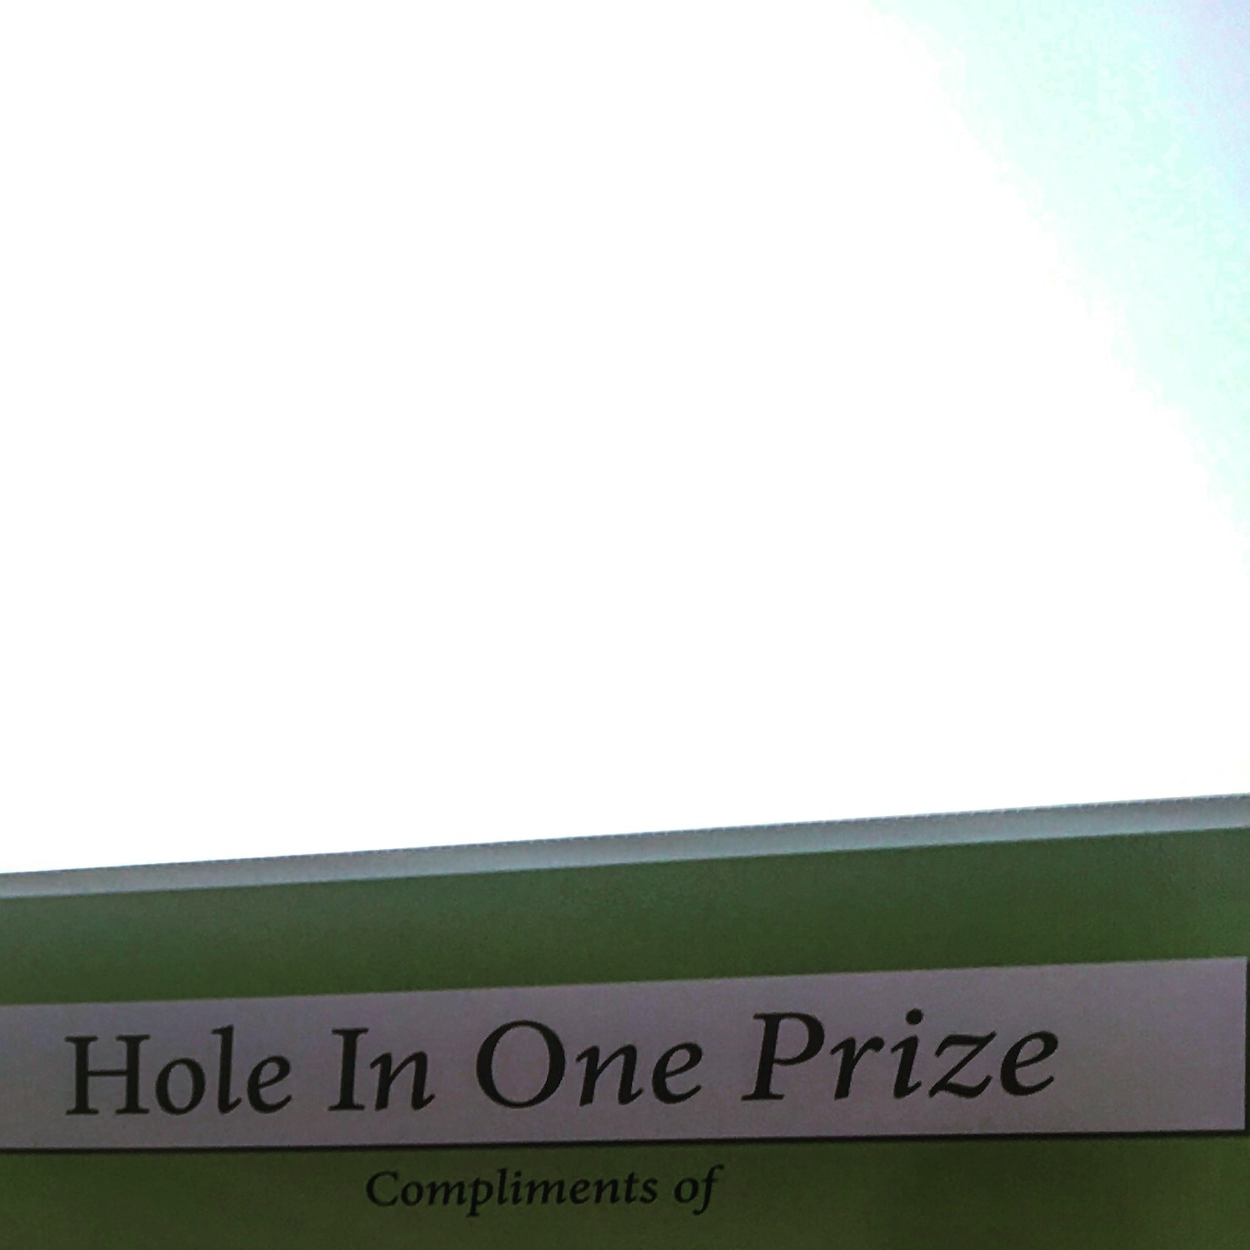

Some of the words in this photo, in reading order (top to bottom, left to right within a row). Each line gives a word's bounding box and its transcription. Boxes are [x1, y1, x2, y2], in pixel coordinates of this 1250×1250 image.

[65, 1026, 292, 1116] Hole
[329, 1027, 436, 1112] In
[476, 1020, 703, 1109] One
[741, 1008, 1059, 1102] Prize
[366, 1168, 658, 1217] Compliments
[674, 1164, 725, 1216] of
